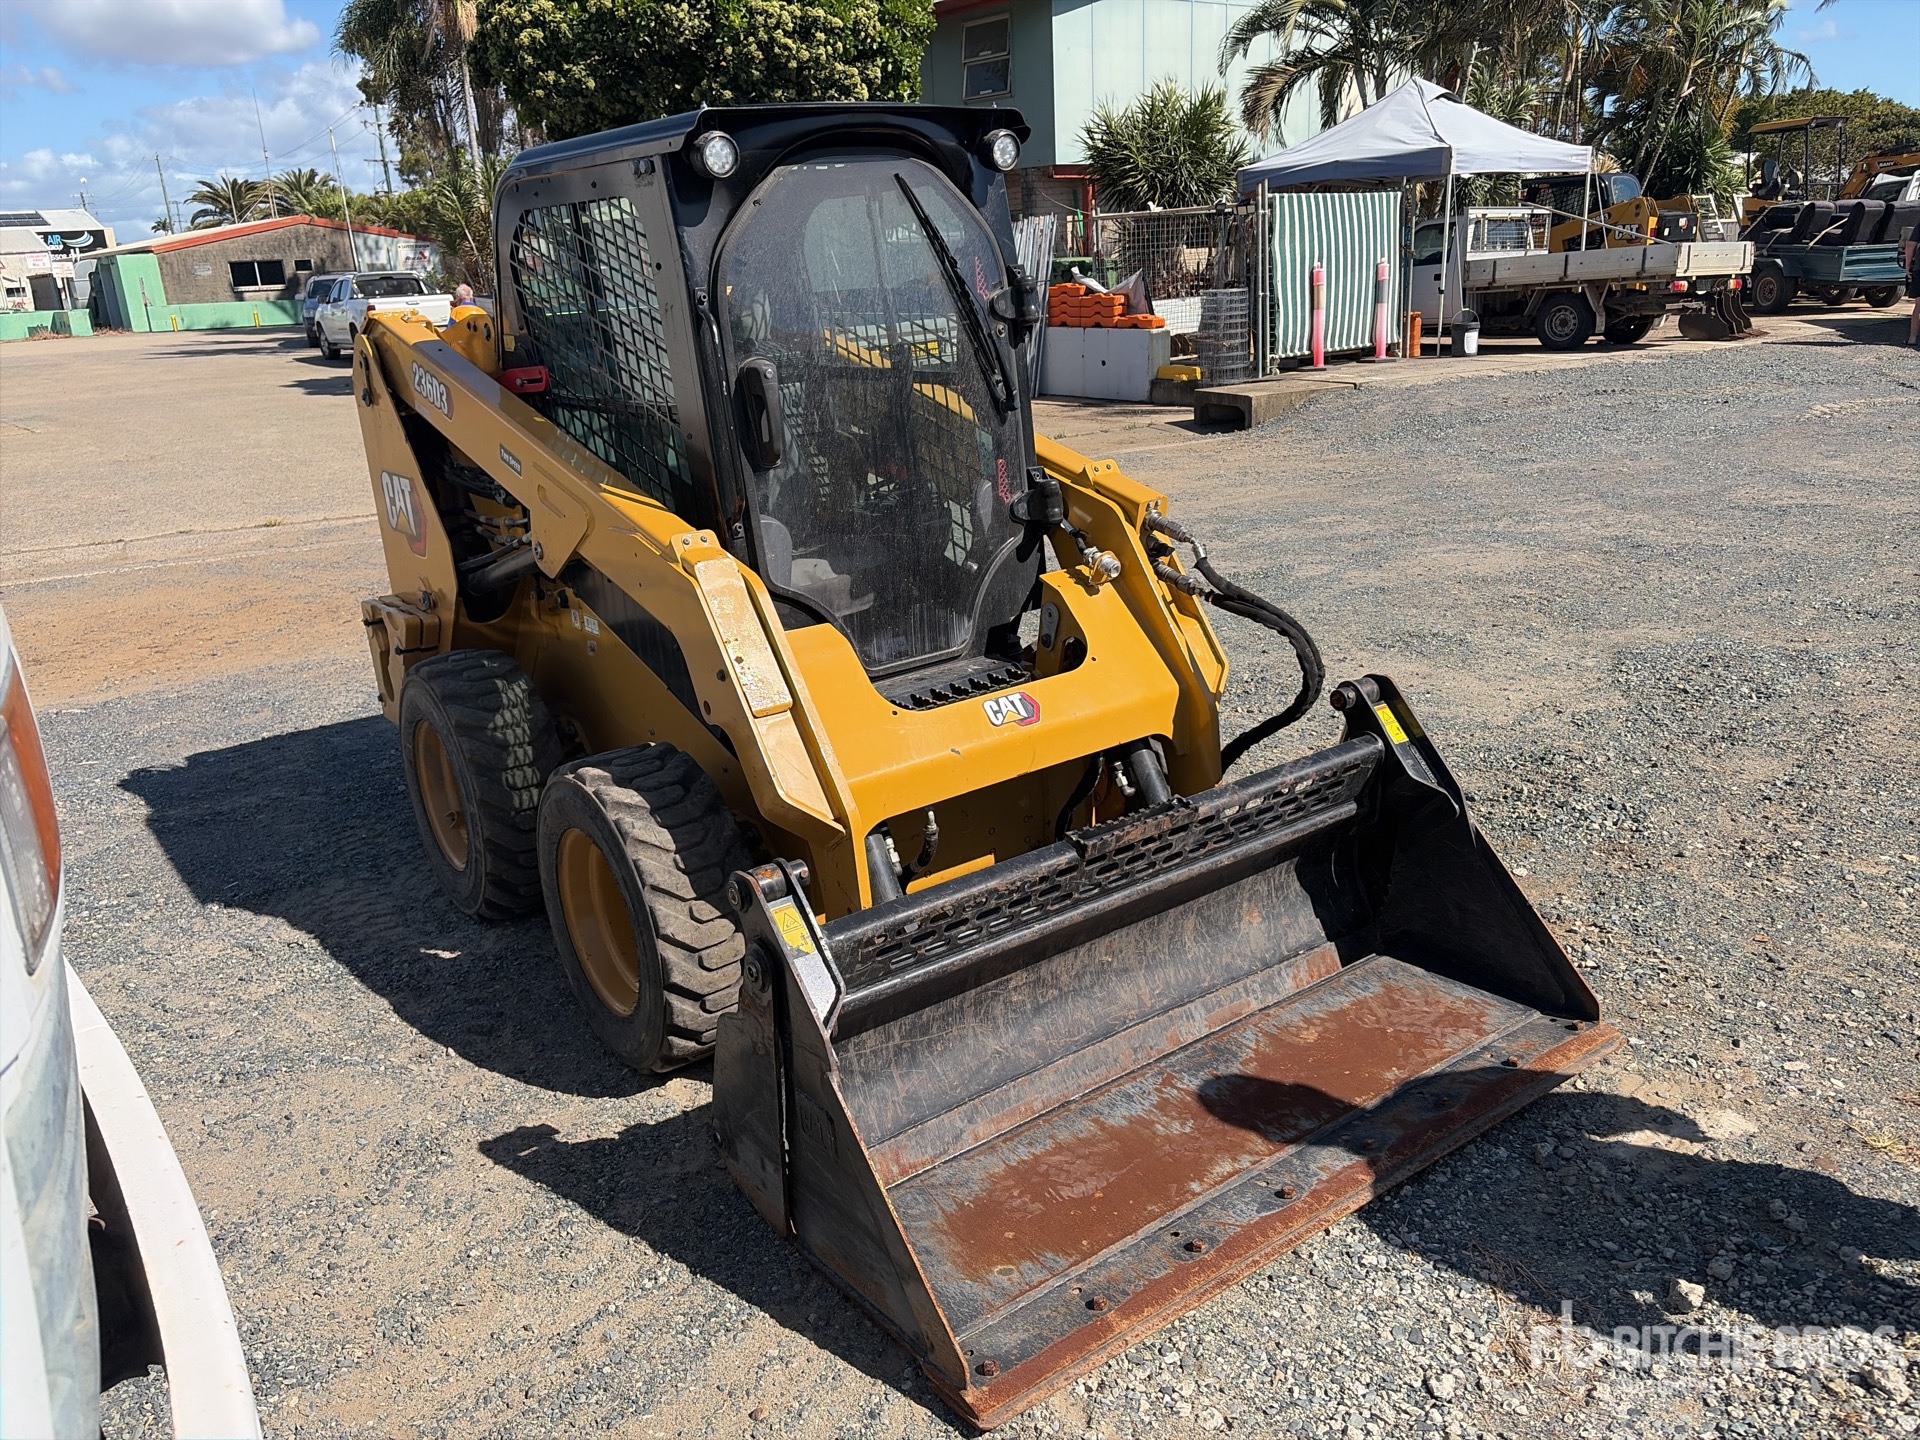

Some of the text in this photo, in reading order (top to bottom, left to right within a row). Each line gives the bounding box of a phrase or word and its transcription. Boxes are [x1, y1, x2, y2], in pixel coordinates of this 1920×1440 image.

[47, 235, 62, 245] AIR
[1614, 224, 1639, 240] CAT
[412, 361, 449, 415] 236D3
[381, 471, 417, 537] CAT
[983, 692, 1029, 726] CAT
